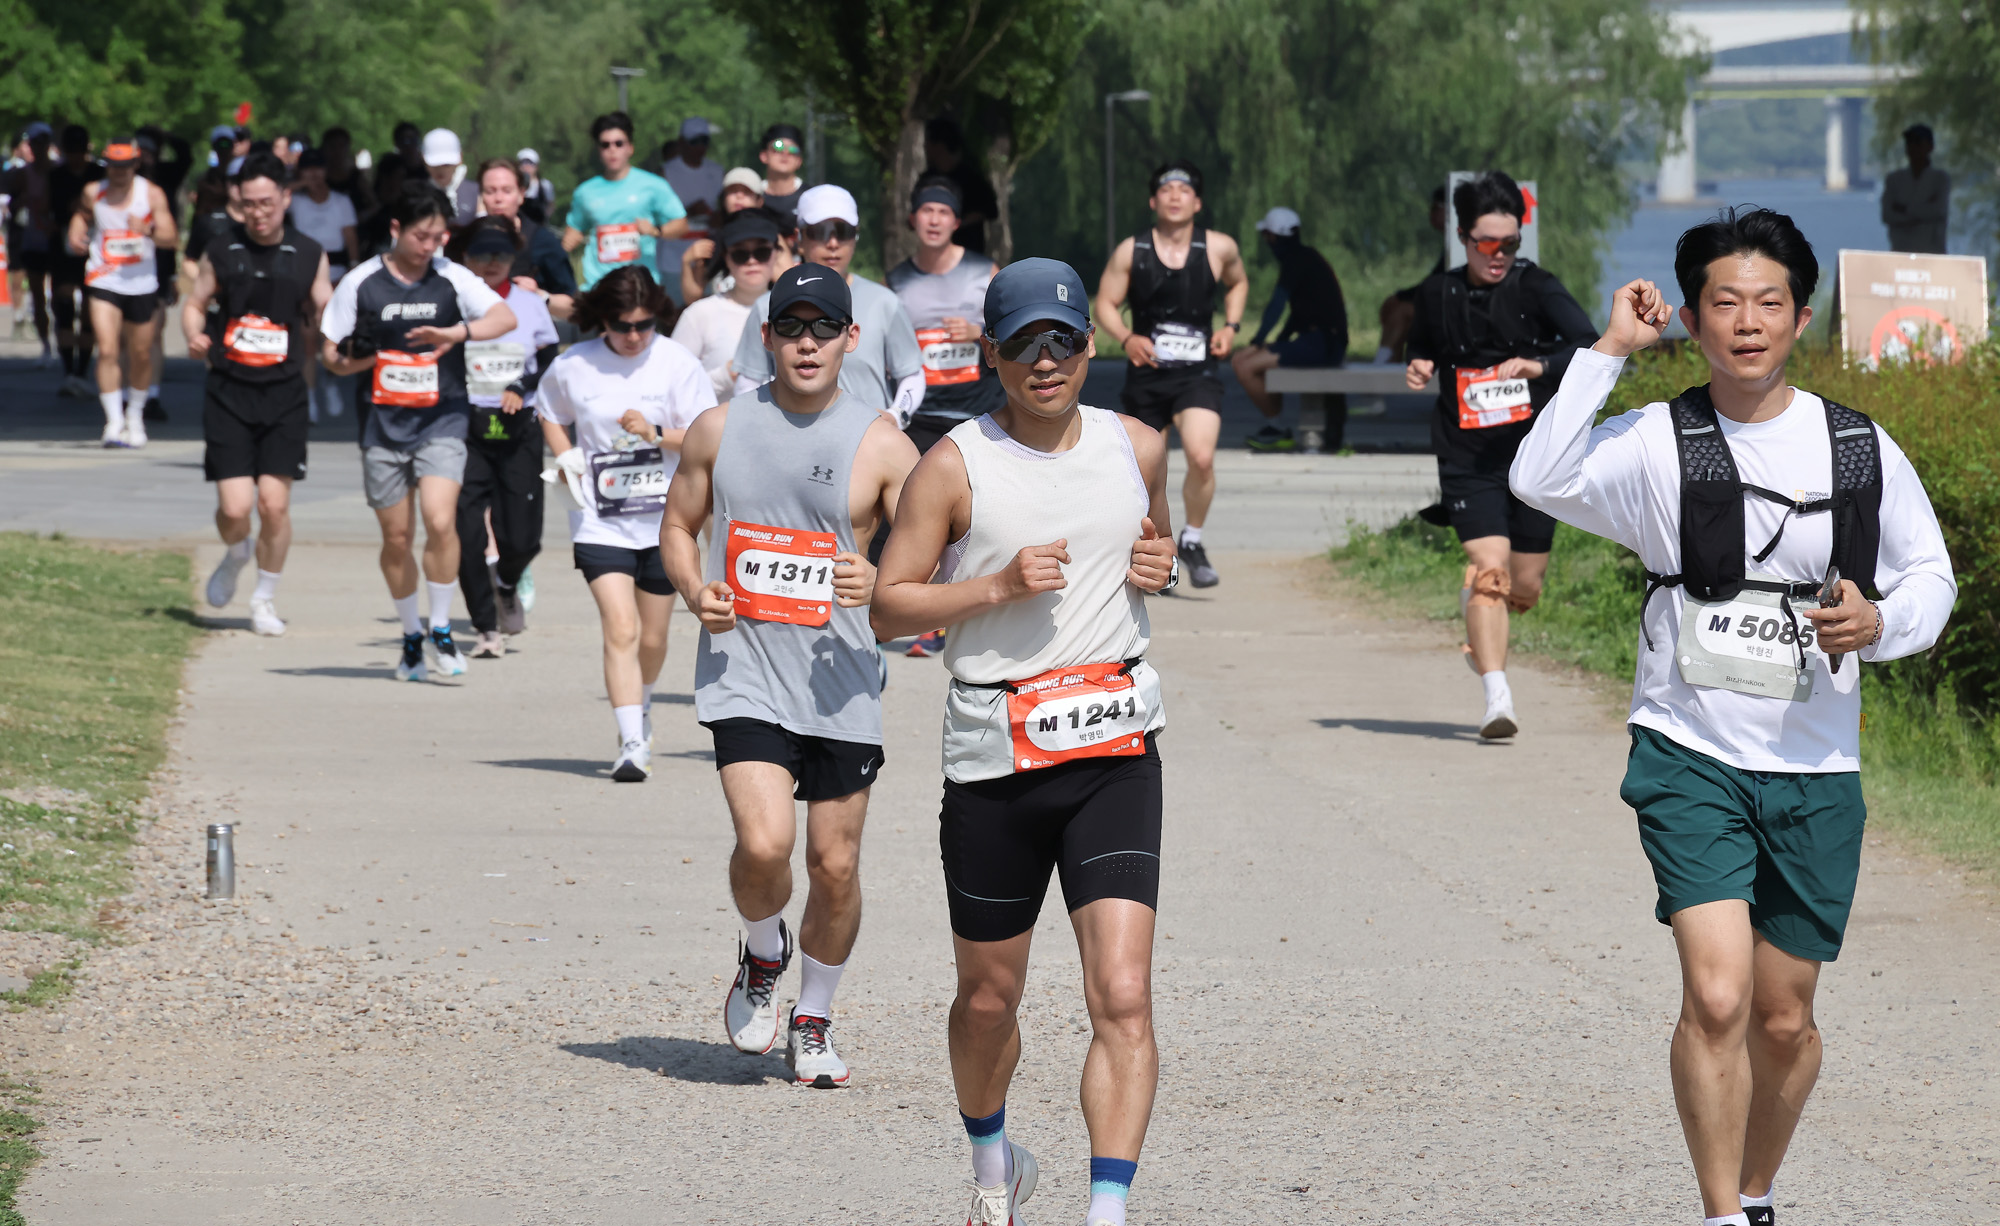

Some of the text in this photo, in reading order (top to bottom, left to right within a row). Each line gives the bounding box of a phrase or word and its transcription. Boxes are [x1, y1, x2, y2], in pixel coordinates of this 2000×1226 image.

[1483, 383, 1524, 399] 1760
[605, 470, 663, 487] W 7512
[734, 527, 794, 543] BURNING RUN
[811, 540, 833, 549] 10km
[745, 561, 827, 585] M 1311
[1708, 614, 1815, 648] M 5085
[1746, 644, 1774, 659] 박형진
[1692, 659, 1715, 669] Bag Drop
[1062, 673, 1085, 686] RUN
[1039, 696, 1136, 732] M 1241
[1079, 729, 1104, 742] 박영민
[1111, 745, 1121, 753] Race
